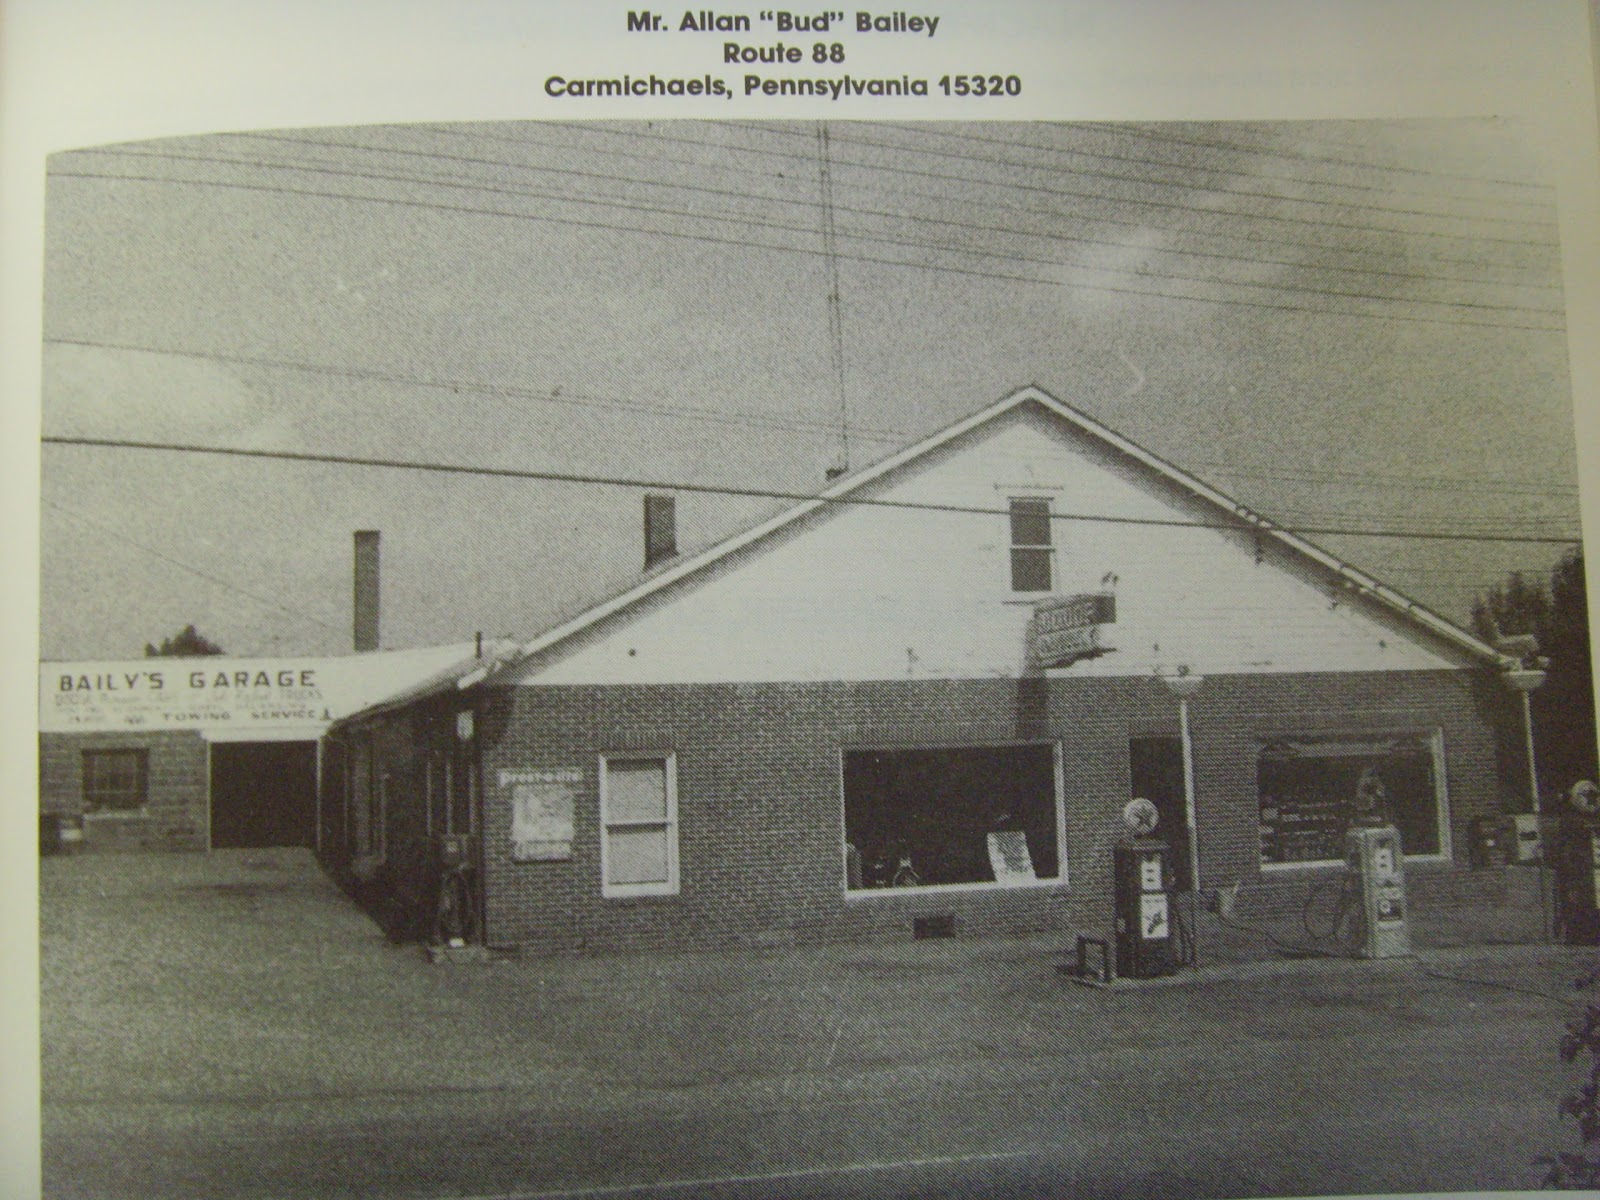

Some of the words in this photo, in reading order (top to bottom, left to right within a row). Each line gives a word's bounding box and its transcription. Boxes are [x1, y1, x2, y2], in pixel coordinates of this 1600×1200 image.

[627, 11, 668, 32] Mr.
[679, 11, 751, 32] Allan
[856, 11, 940, 37] Bailey
[724, 43, 803, 63] Route
[812, 43, 845, 63] 88
[544, 75, 733, 100] Carmichaels,
[744, 75, 928, 101] Pennsylvania
[938, 75, 1022, 97] 15320
[59, 671, 165, 692] BAILY'S
[189, 669, 316, 689] GARAGE
[163, 711, 231, 722] TOWING
[251, 709, 316, 721] SERVICE
